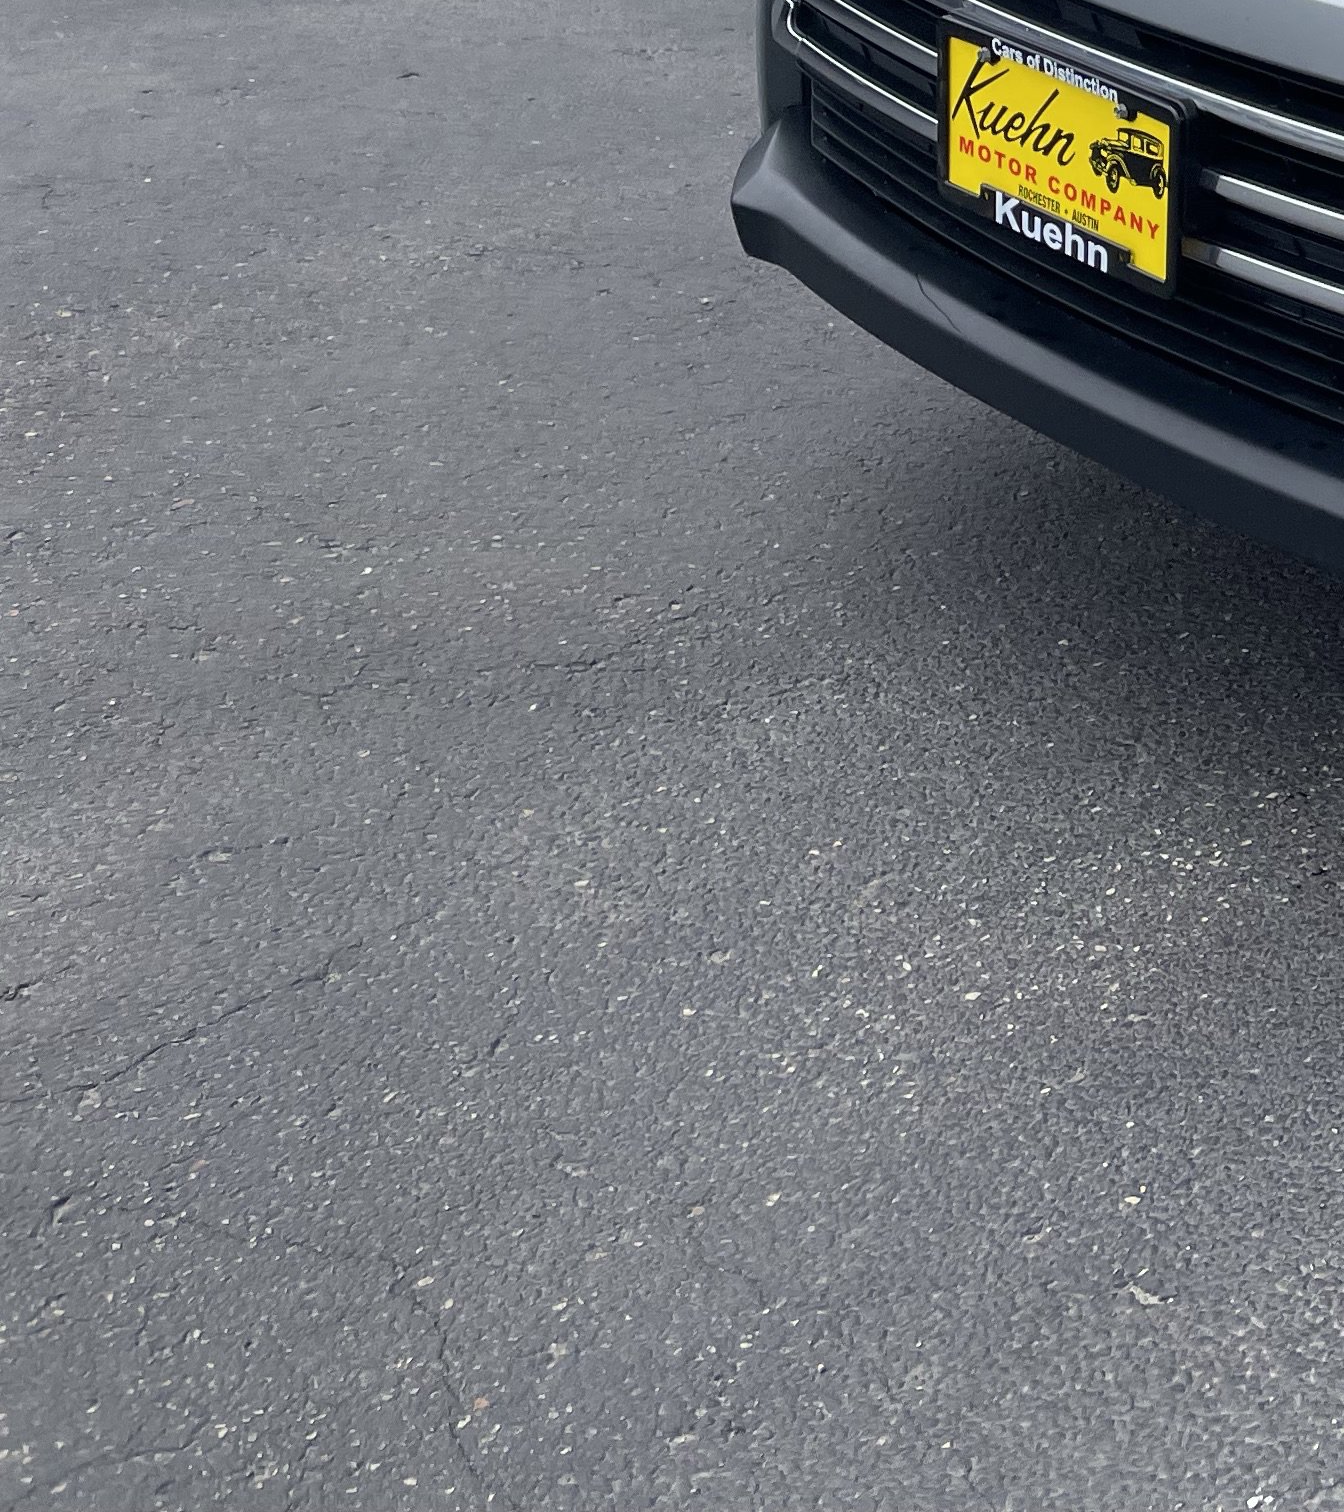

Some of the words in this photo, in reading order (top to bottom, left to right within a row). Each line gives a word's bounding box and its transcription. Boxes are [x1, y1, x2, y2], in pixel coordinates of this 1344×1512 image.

[952, 57, 1076, 166] Kuehn
[991, 38, 1023, 65] Cars
[1026, 54, 1041, 72] of
[1043, 58, 1119, 103] Distinction
[959, 136, 1037, 185] MOTOR
[1048, 175, 1160, 240] COMPANY
[1018, 184, 1061, 214] ROCHESTER
[1071, 209, 1100, 232] AUSTIN
[995, 190, 1108, 273] Kuehn
